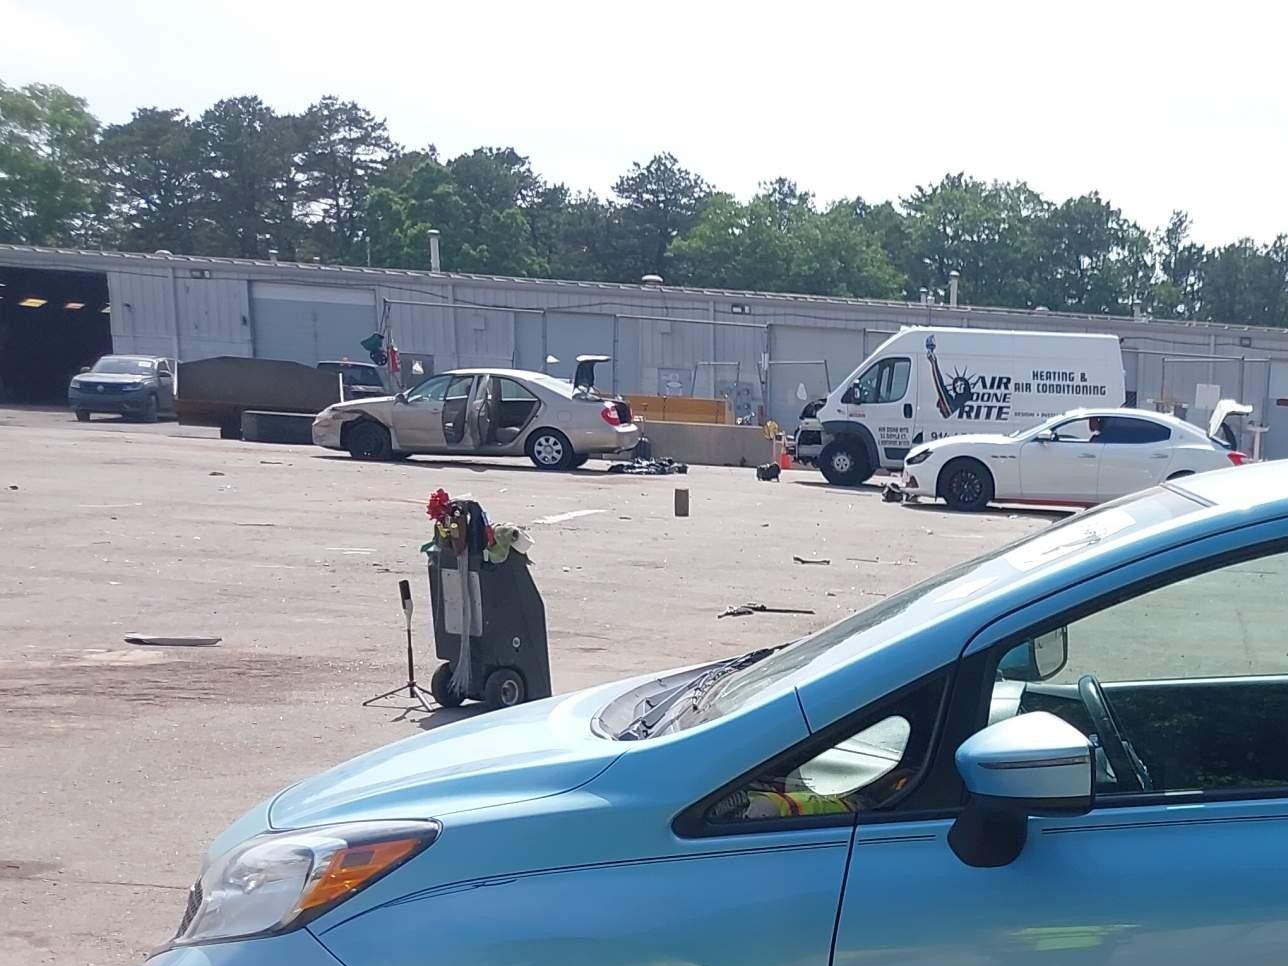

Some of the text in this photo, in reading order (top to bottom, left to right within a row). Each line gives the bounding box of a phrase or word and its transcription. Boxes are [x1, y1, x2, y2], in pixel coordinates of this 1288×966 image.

[972, 375, 1012, 390] AIR
[1032, 370, 1088, 383] HEATING &
[1014, 383, 1107, 396] AIR CONDITIONING
[972, 391, 1012, 403] DONE
[957, 405, 1012, 421] RITE
